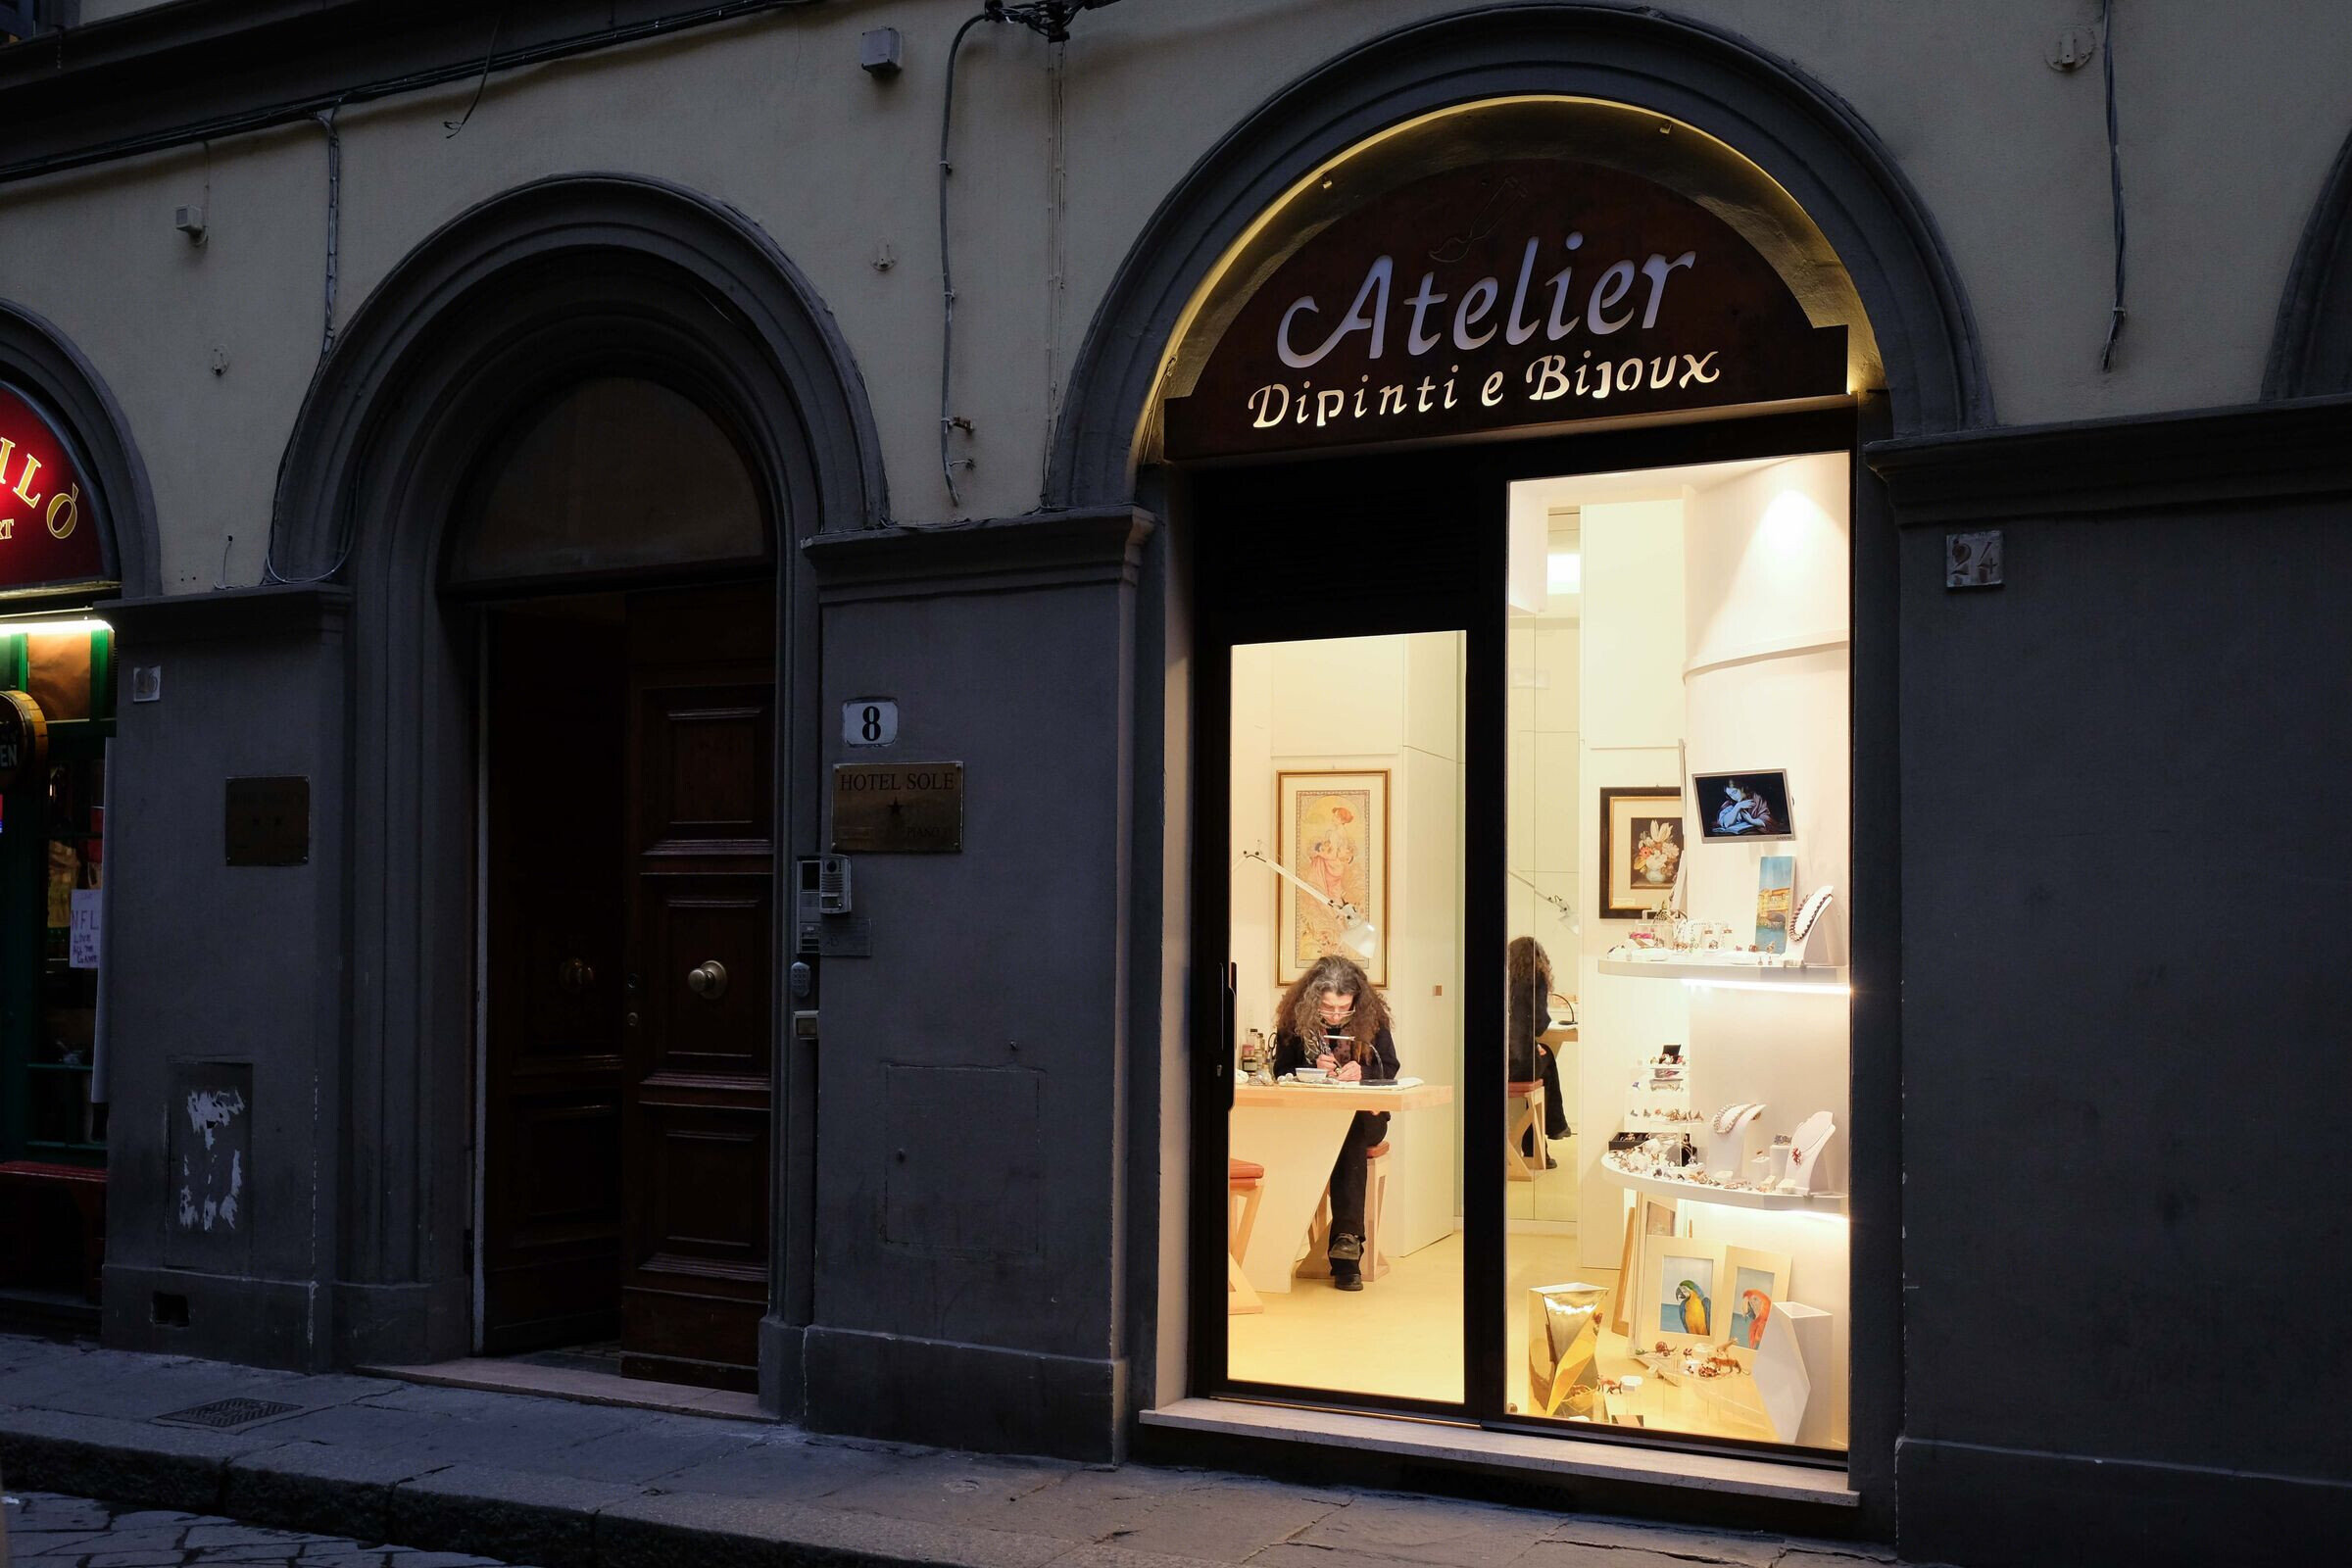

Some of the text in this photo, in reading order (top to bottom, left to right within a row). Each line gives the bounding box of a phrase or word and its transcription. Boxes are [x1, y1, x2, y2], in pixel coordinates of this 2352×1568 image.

[1276, 230, 1697, 368] Atelier
[1248, 349, 1721, 428] Dipinti e Bijoux
[861, 706, 881, 741] 8
[840, 772, 955, 791] HOTEL SOLE
[72, 909, 99, 930] NFL
